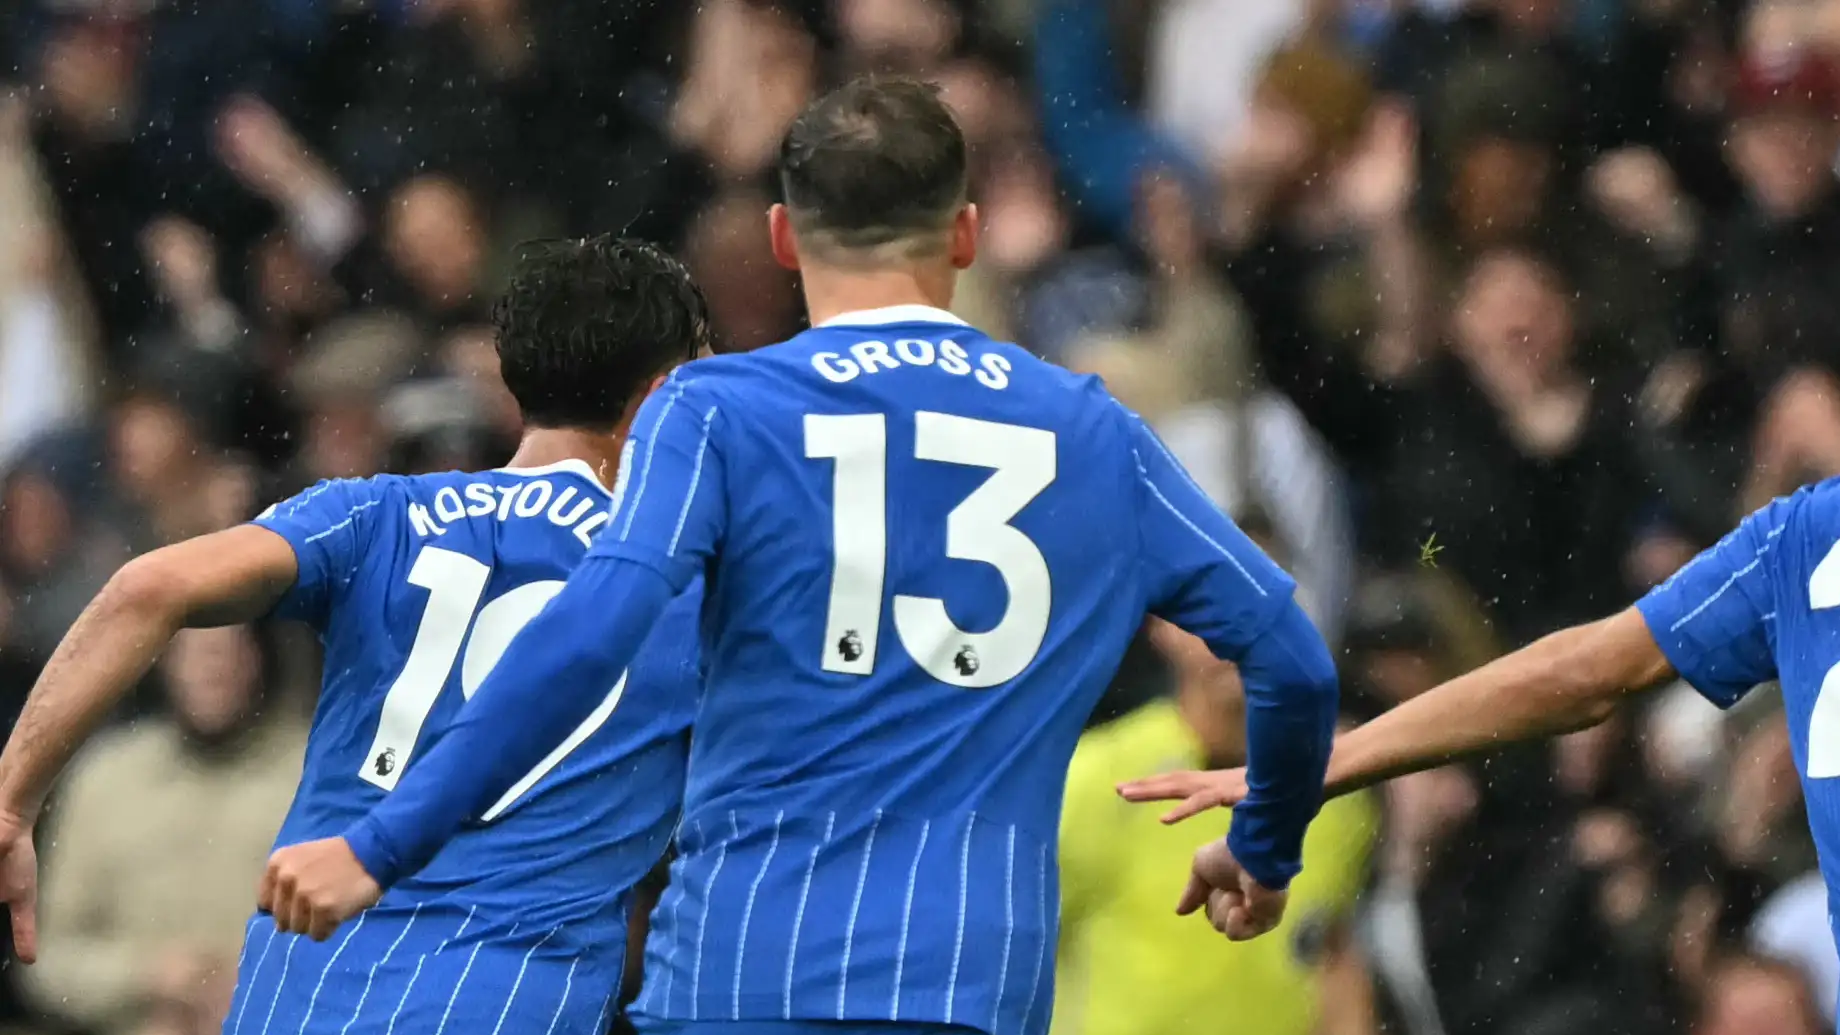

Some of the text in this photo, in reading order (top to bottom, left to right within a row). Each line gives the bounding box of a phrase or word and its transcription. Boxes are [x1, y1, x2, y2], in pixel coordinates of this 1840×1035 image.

[811, 338, 1012, 390] GROSS
[408, 480, 609, 550] KOSTOUL
[803, 410, 1056, 688] 13
